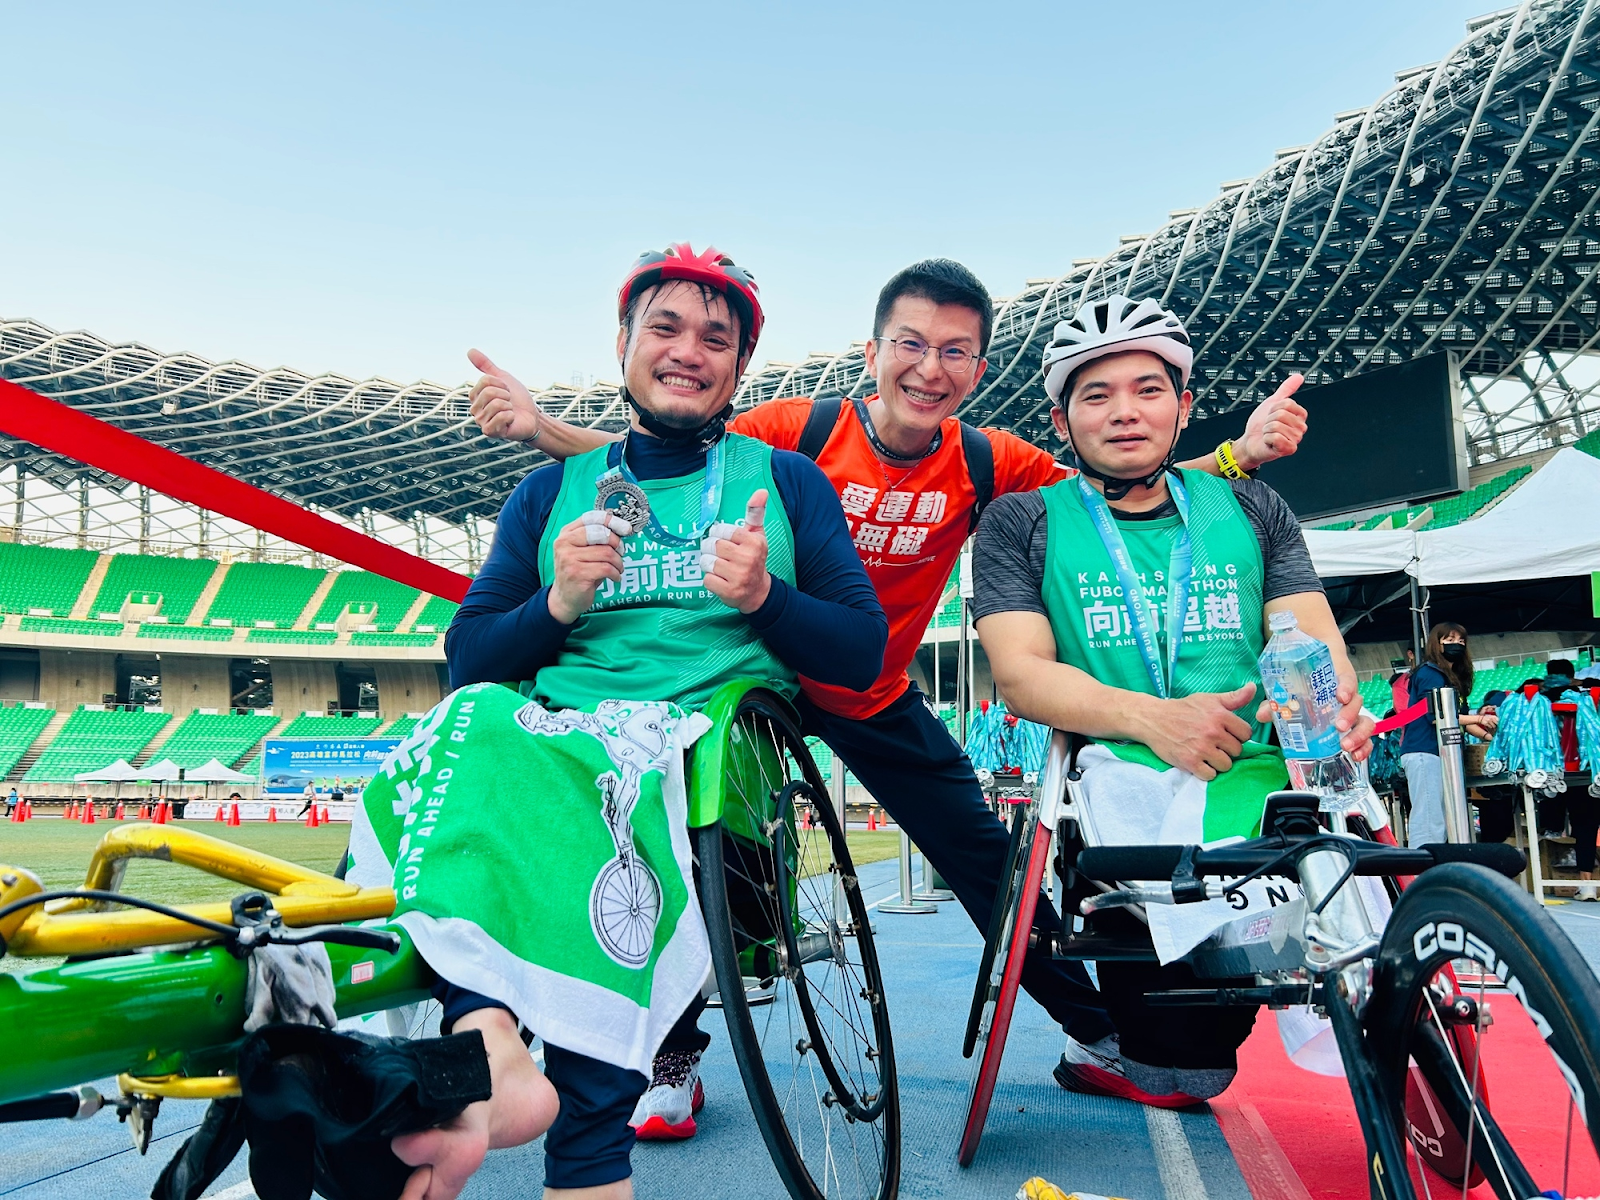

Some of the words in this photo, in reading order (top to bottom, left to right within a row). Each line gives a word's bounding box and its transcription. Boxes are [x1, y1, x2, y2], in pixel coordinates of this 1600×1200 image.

[600, 475, 619, 486] 2023
[841, 481, 948, 524] 愛運動
[142, 594, 149, 604] E
[609, 594, 651, 607] AHEAD
[668, 591, 693, 600] RUN
[1080, 586, 1123, 599] FUBO
[1144, 578, 1238, 597] MATHON
[359, 604, 366, 613] E
[1130, 588, 1148, 630] BEYOND
[1089, 638, 1111, 649] RUN
[1116, 637, 1137, 648] AHE
[1198, 632, 1244, 642] BEYOND
[1142, 632, 1153, 653] RUN
[1151, 662, 1164, 697] AHEAD
[402, 846, 425, 900] RUN
[417, 767, 454, 838] AHEAD
[450, 700, 475, 742] RUN
